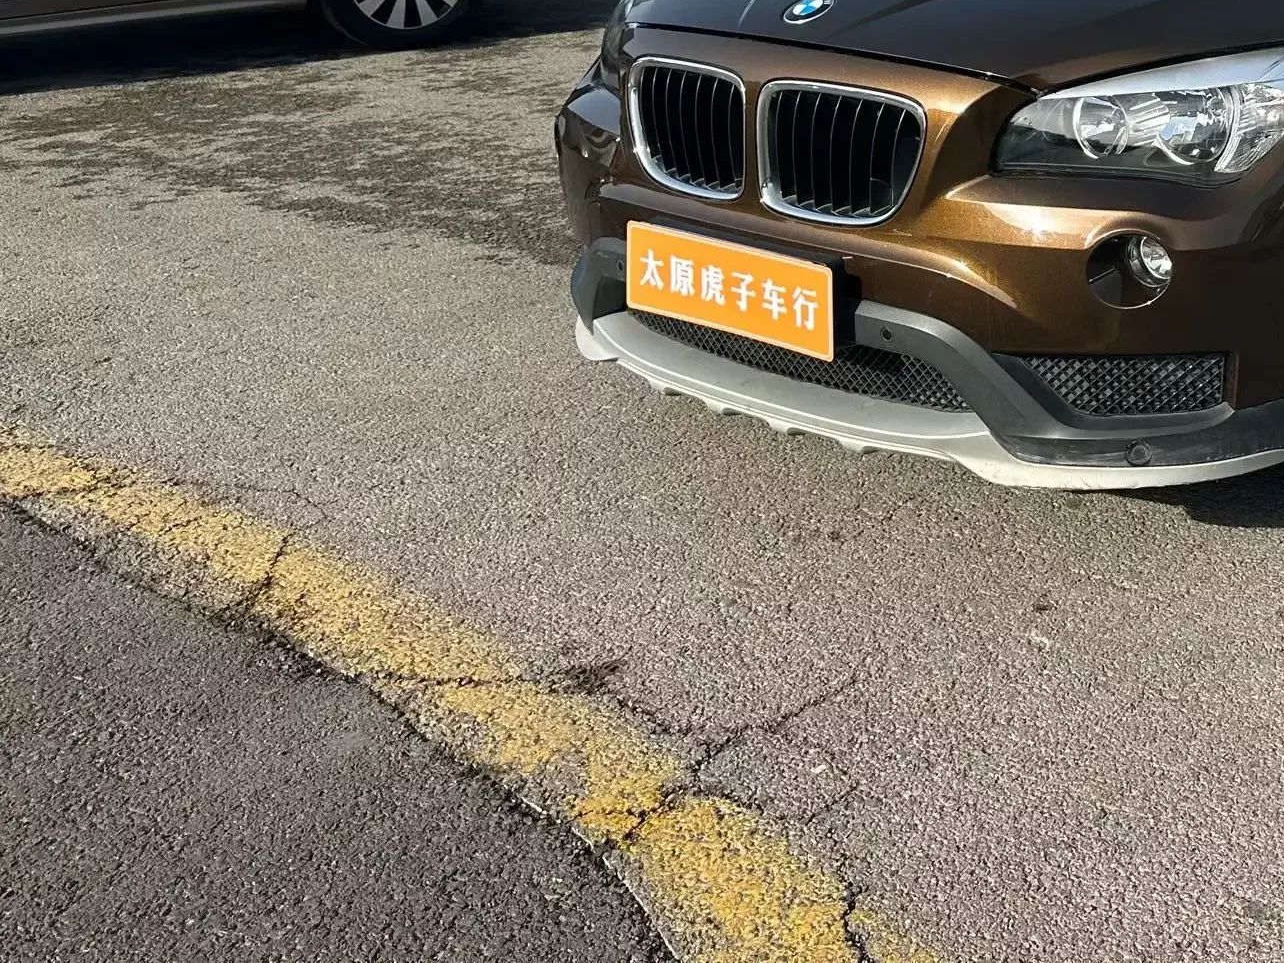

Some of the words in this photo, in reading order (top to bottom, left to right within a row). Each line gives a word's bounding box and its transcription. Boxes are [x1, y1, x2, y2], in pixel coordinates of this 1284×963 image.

[639, 248, 819, 331] 太原虎子车行
